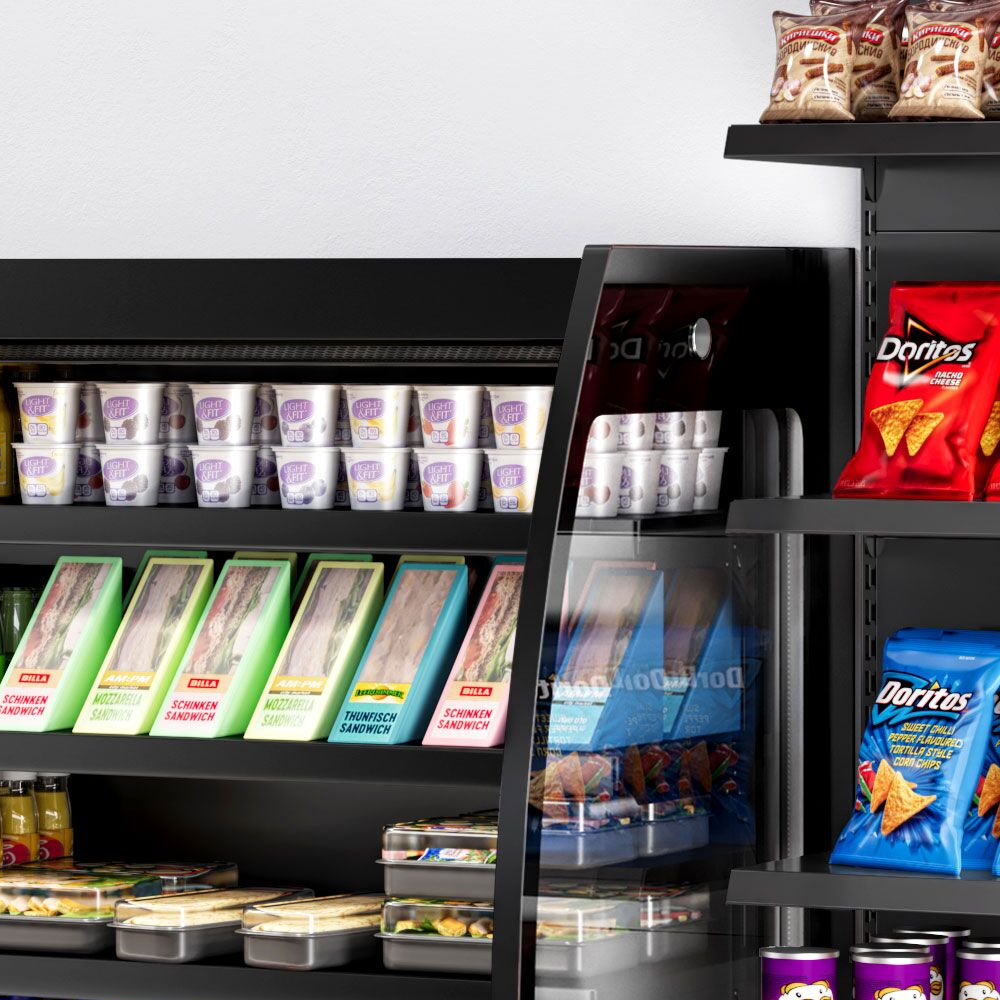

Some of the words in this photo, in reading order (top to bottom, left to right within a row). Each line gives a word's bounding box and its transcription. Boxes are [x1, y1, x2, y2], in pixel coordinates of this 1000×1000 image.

[877, 337, 976, 362] Doritos
[934, 371, 963, 379] NACHO
[21, 673, 48, 683] BILLA
[190, 678, 218, 688] BILLA
[462, 687, 491, 696] BILLA
[876, 681, 972, 711] Doritos
[3, 695, 48, 704] SCHINKEN
[92, 693, 142, 705] MOZZARELLA
[263, 698, 314, 711] MOZZARELLA
[171, 700, 218, 710] SCHINKEN
[90, 708, 133, 720] SANDWICH
[165, 711, 216, 721] SANDWICH
[344, 711, 397, 722] THUNFISCH
[444, 708, 492, 719] SCHINKEN
[262, 714, 305, 727] SANDWICH
[437, 719, 490, 730] SANDWICH
[340, 723, 392, 734] SANDWICH
[901, 723, 931, 732] SWEET
[888, 733, 917, 743] PEPPER
[890, 745, 924, 757] TORTILLA
[926, 747, 954, 758] STYLE
[893, 757, 916, 767] CORN
[916, 759, 941, 770] CHIPS
